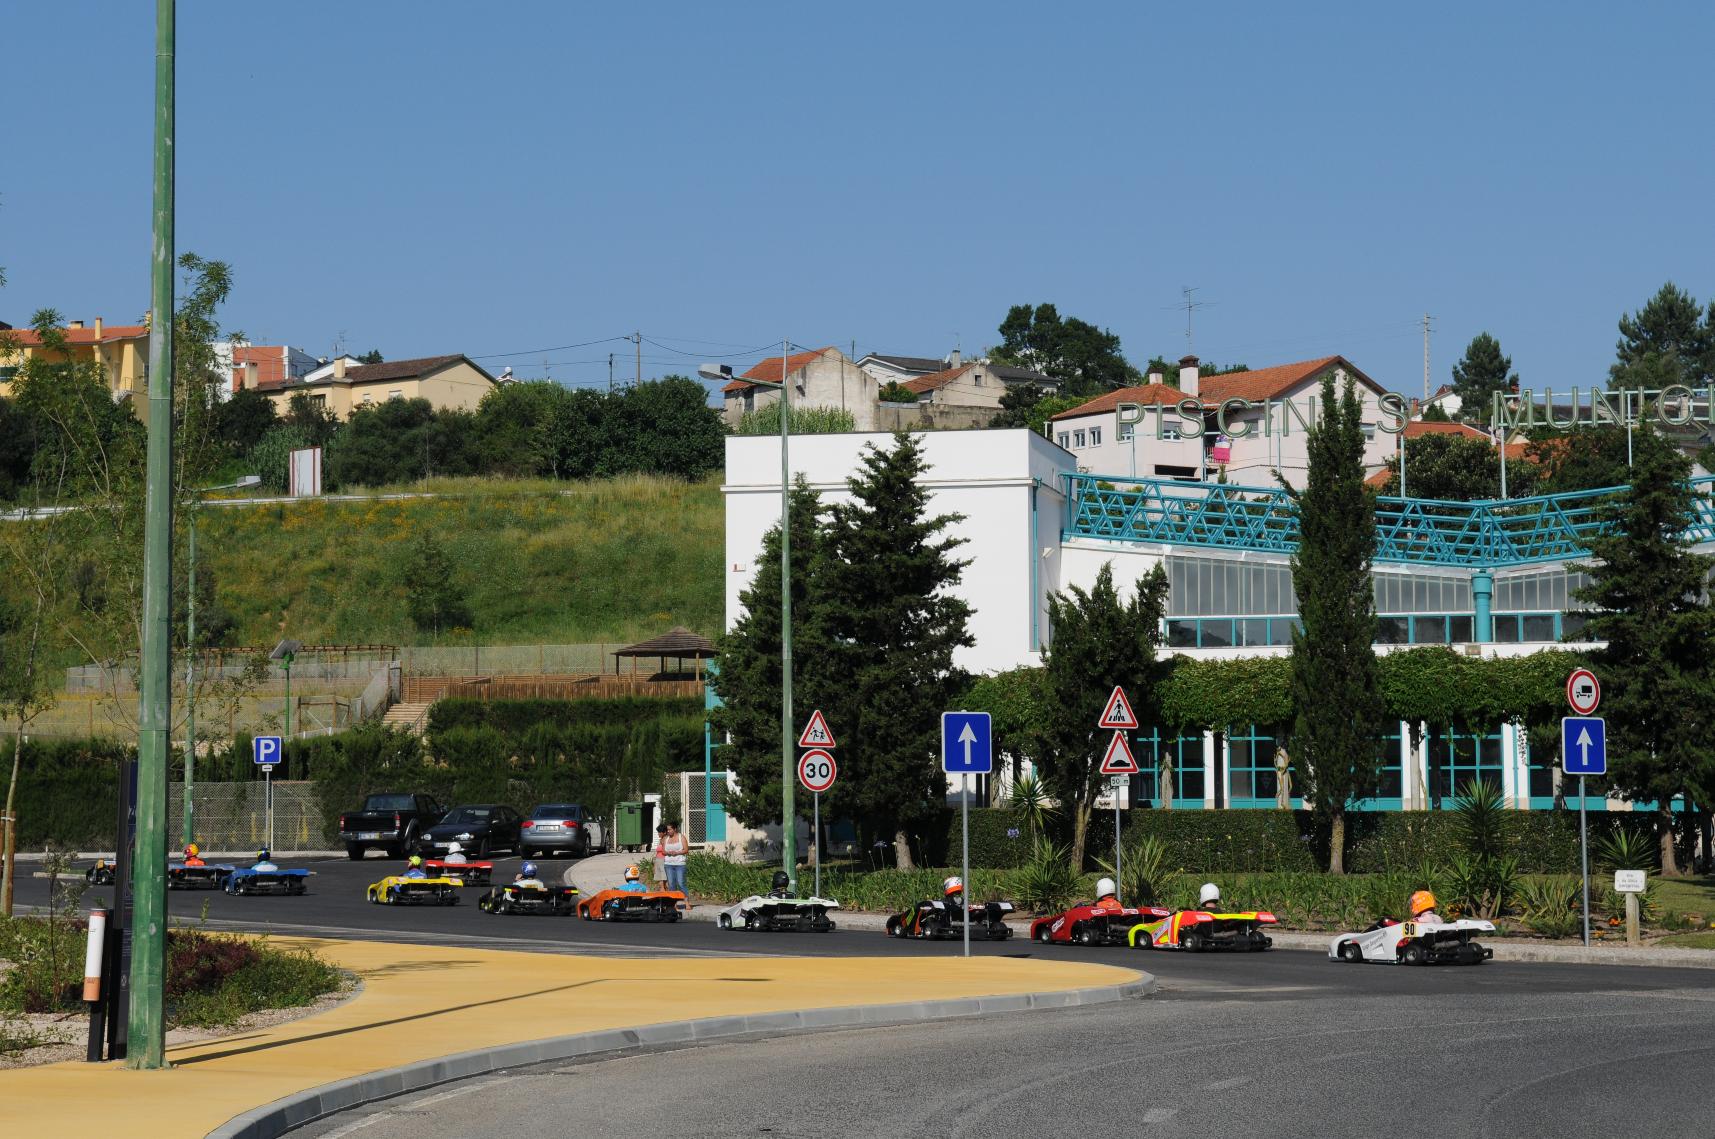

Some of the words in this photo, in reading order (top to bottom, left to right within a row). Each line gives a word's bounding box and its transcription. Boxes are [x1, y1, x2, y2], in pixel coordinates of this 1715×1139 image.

[1115, 391, 1409, 441] PISCINS
[260, 739, 276, 761] P
[806, 763, 830, 778] 30
[1404, 922, 1415, 936] 90
